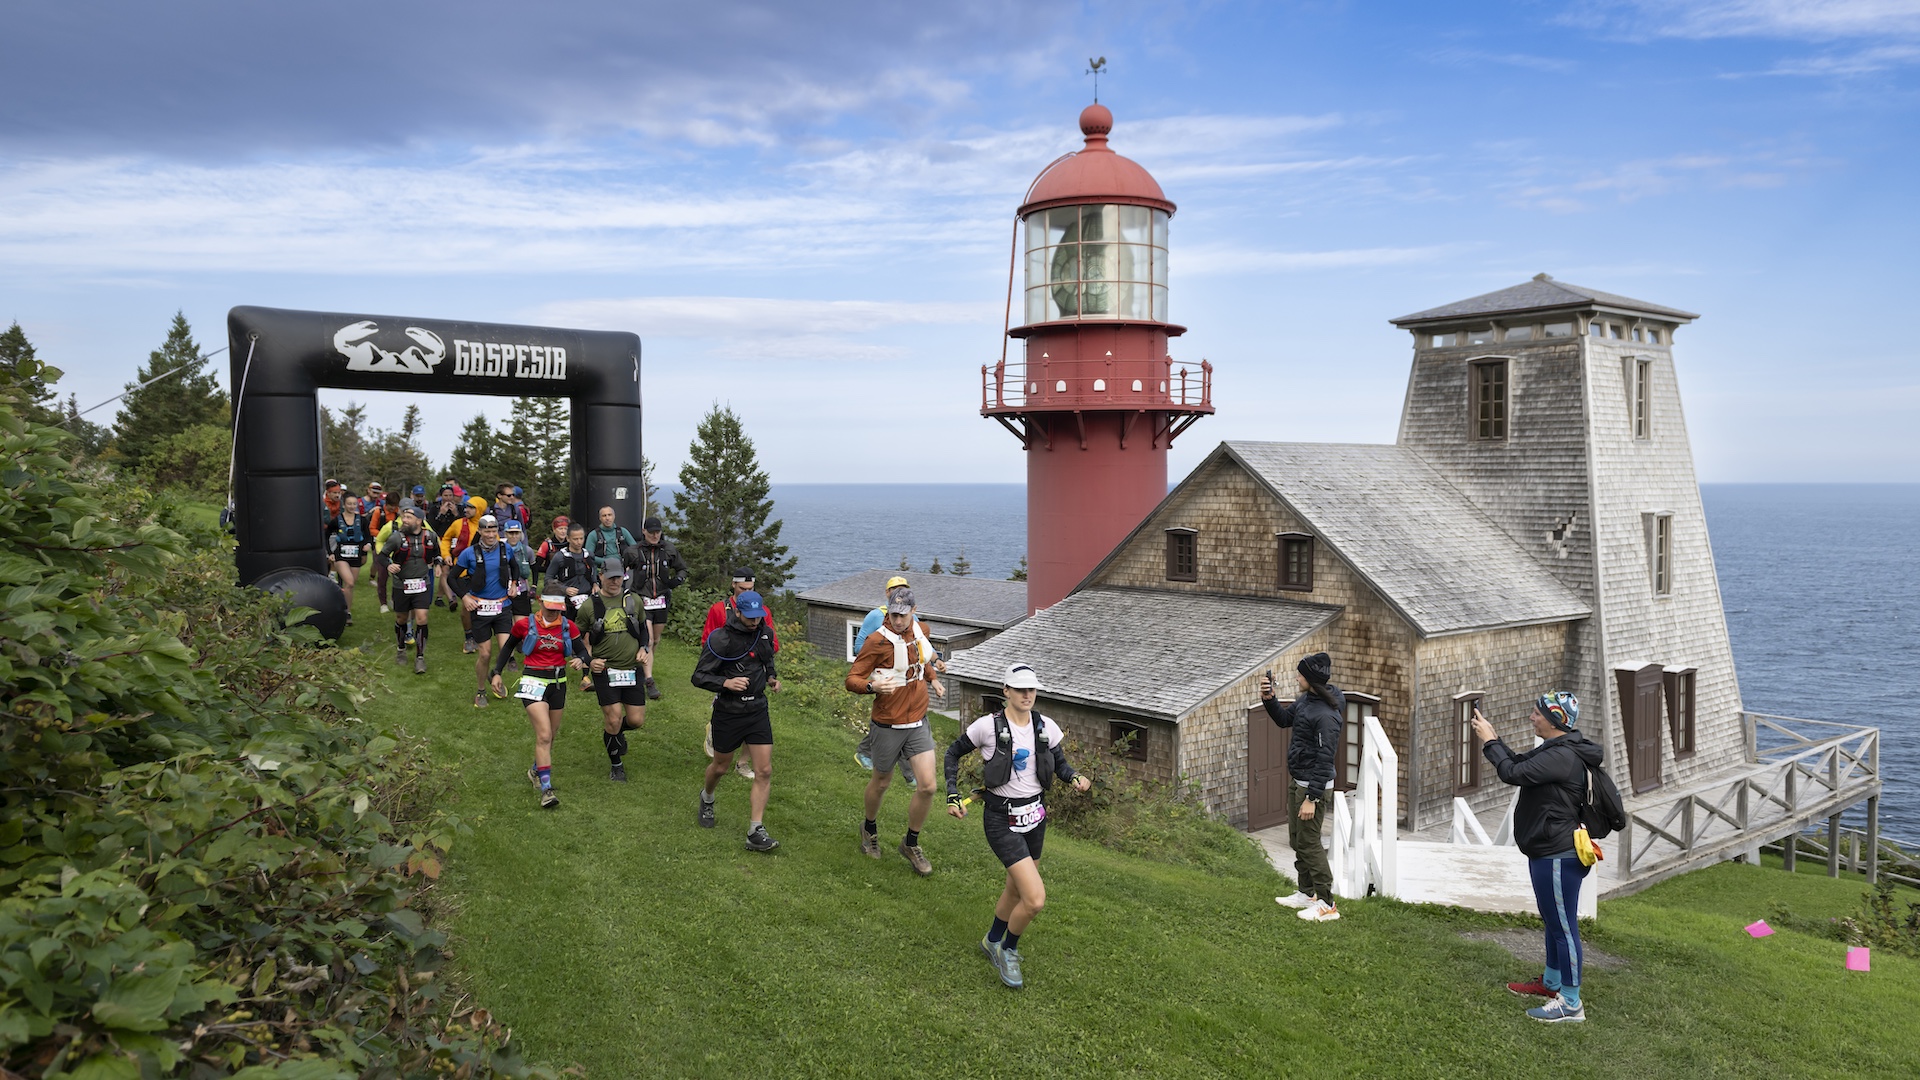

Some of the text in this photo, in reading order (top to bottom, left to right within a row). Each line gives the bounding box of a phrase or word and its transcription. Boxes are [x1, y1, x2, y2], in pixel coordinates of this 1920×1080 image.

[453, 339, 566, 380] GASPESIA
[615, 673, 630, 681] 811
[521, 684, 538, 694] 807
